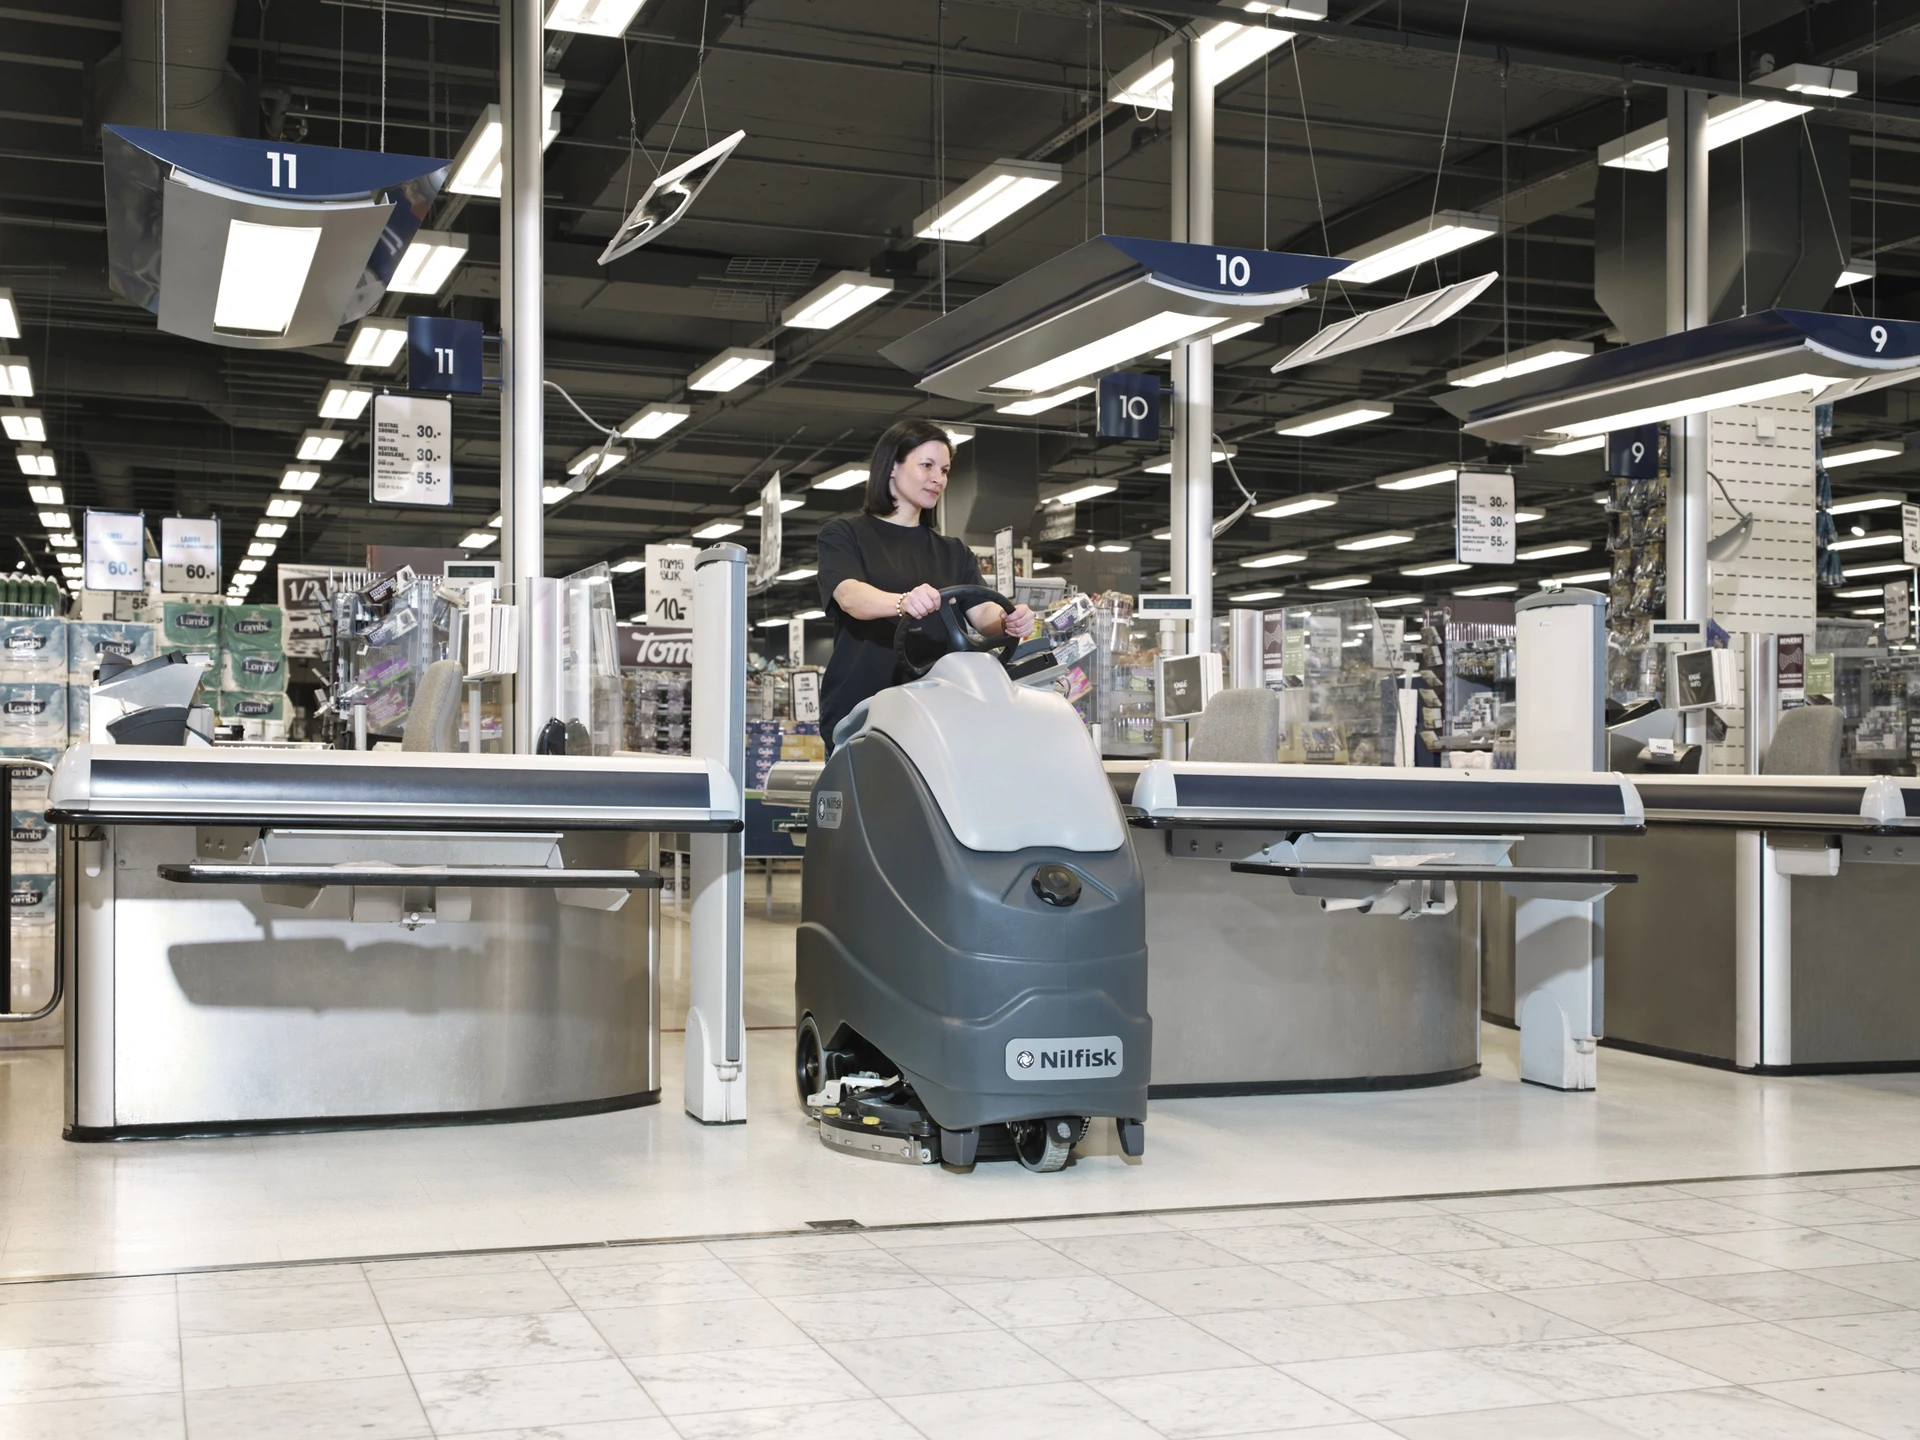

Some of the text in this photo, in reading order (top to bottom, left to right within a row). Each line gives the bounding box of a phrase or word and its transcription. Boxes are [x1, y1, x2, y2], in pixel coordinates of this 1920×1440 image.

[266, 151, 298, 189] 11
[1216, 254, 1251, 287] 10
[1870, 325, 1888, 352] 9
[434, 348, 454, 375] 11
[1119, 395, 1149, 420] 10
[416, 425, 441, 438] 30.-
[416, 449, 441, 462] 30.-
[1631, 441, 1645, 463] 9
[416, 472, 441, 485] 55.-
[1490, 496, 1508, 507] 30.-
[1490, 516, 1509, 527] 30.-
[1490, 536, 1509, 547] 55.-
[107, 560, 138, 576] 60.-
[185, 563, 216, 579] 60.-
[180, 616, 210, 626] Lambi
[238, 620, 268, 632] Lambi
[631, 631, 693, 664] Tom
[245, 661, 276, 672] Lambi
[8, 701, 41, 713] Lambi
[239, 703, 269, 713] Lambi
[11, 768, 38, 777] ambi
[11, 893, 38, 904] ambi
[1040, 1048, 1117, 1069] Nilfisk
